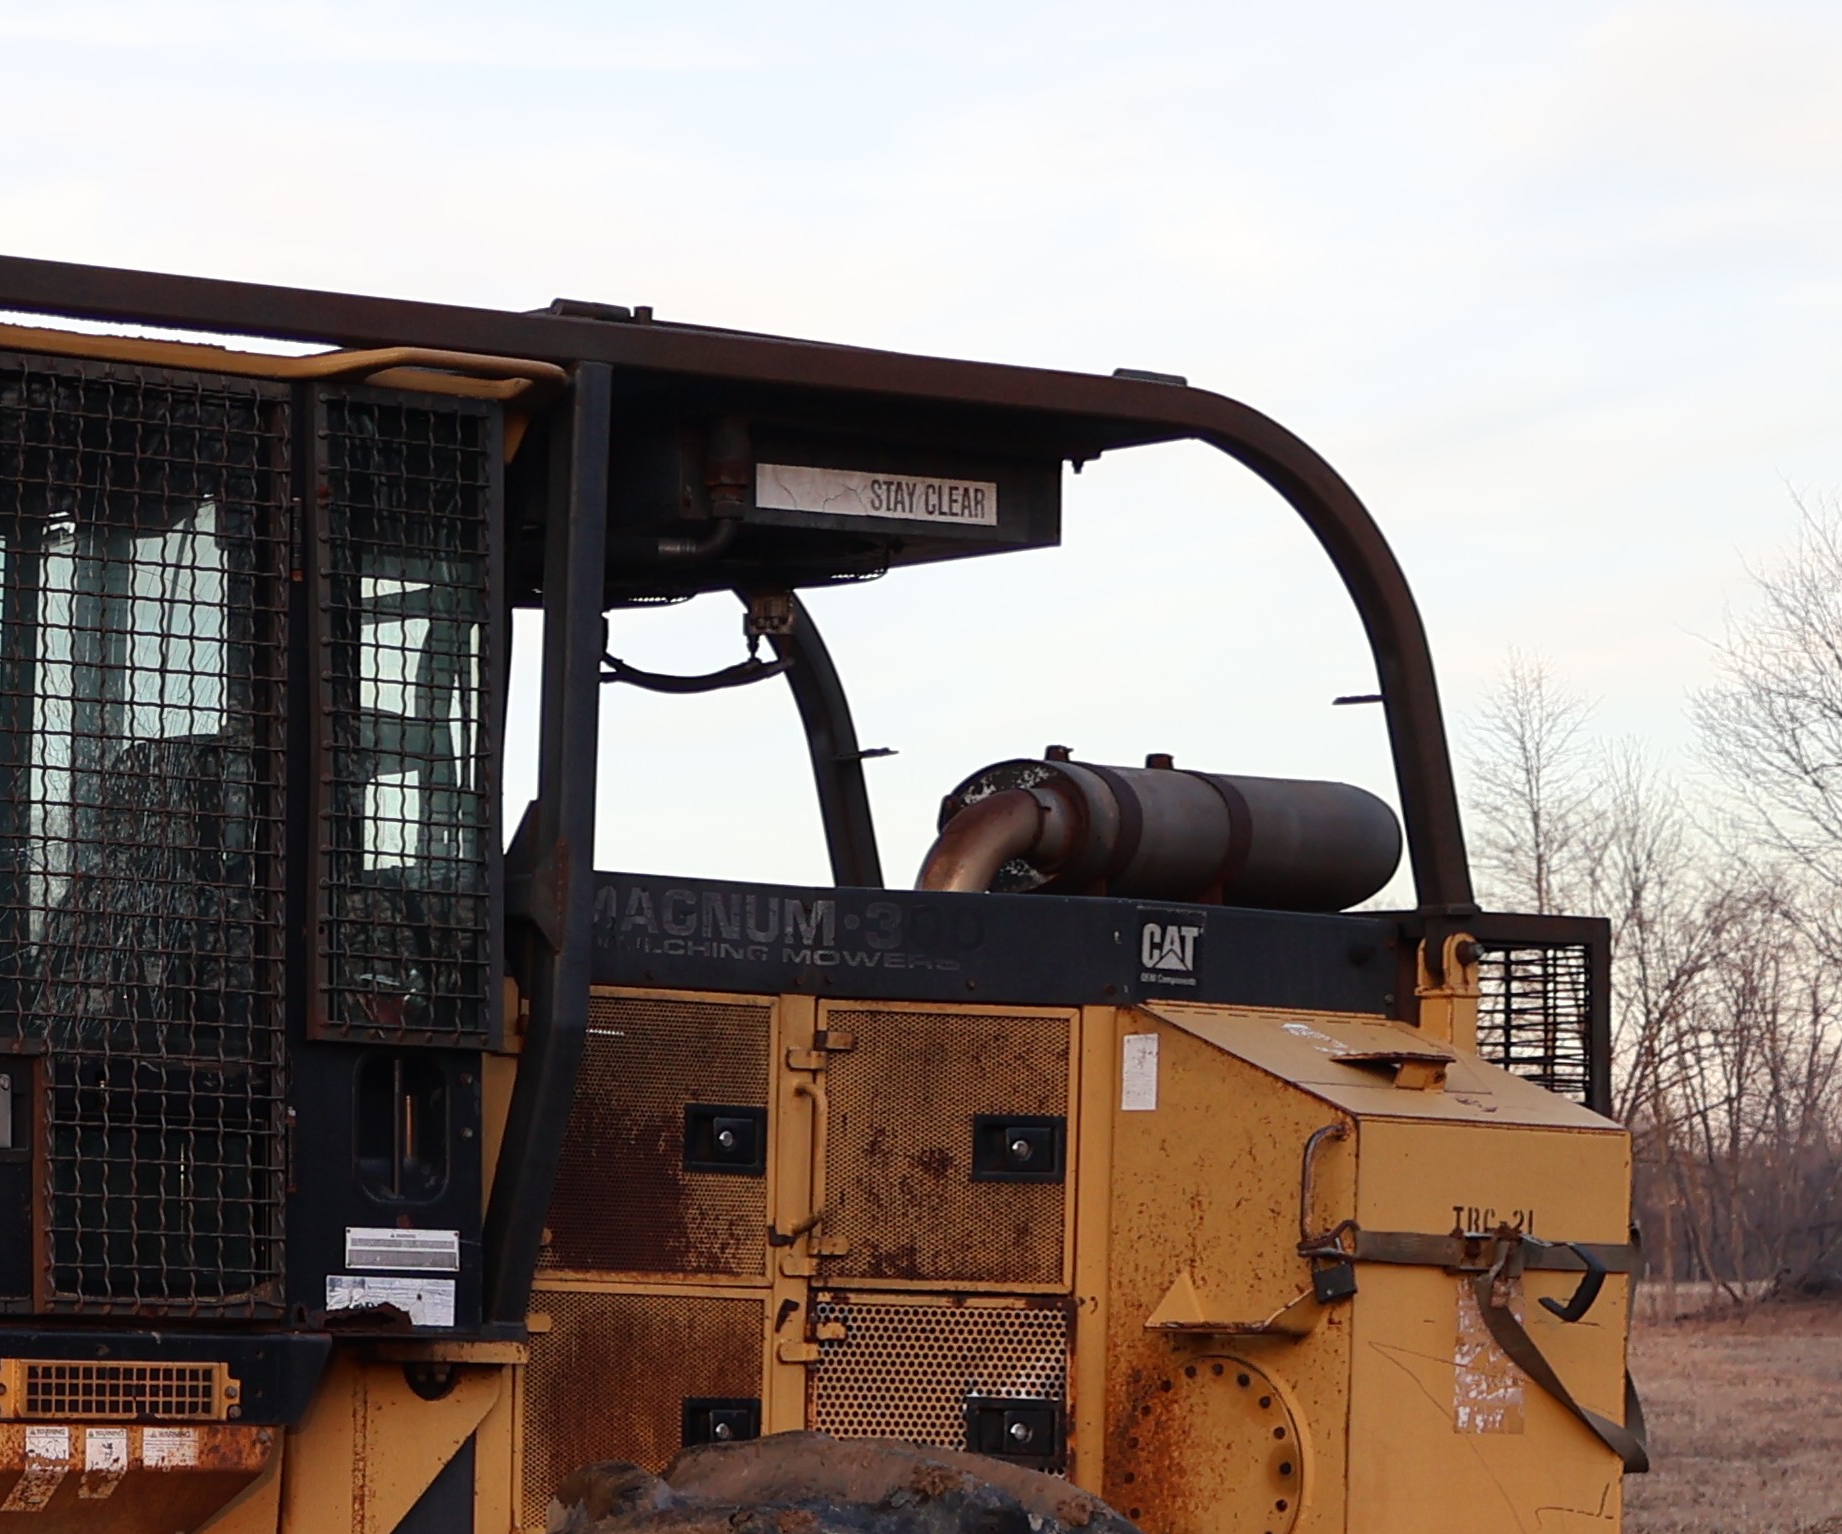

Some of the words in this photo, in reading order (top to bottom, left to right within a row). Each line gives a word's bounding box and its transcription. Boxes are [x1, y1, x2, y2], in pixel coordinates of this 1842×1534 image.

[871, 479, 917, 513] STAY
[924, 483, 986, 519] CLEAR
[781, 947, 961, 972] MOWERS
[1140, 922, 1200, 972] CAT
